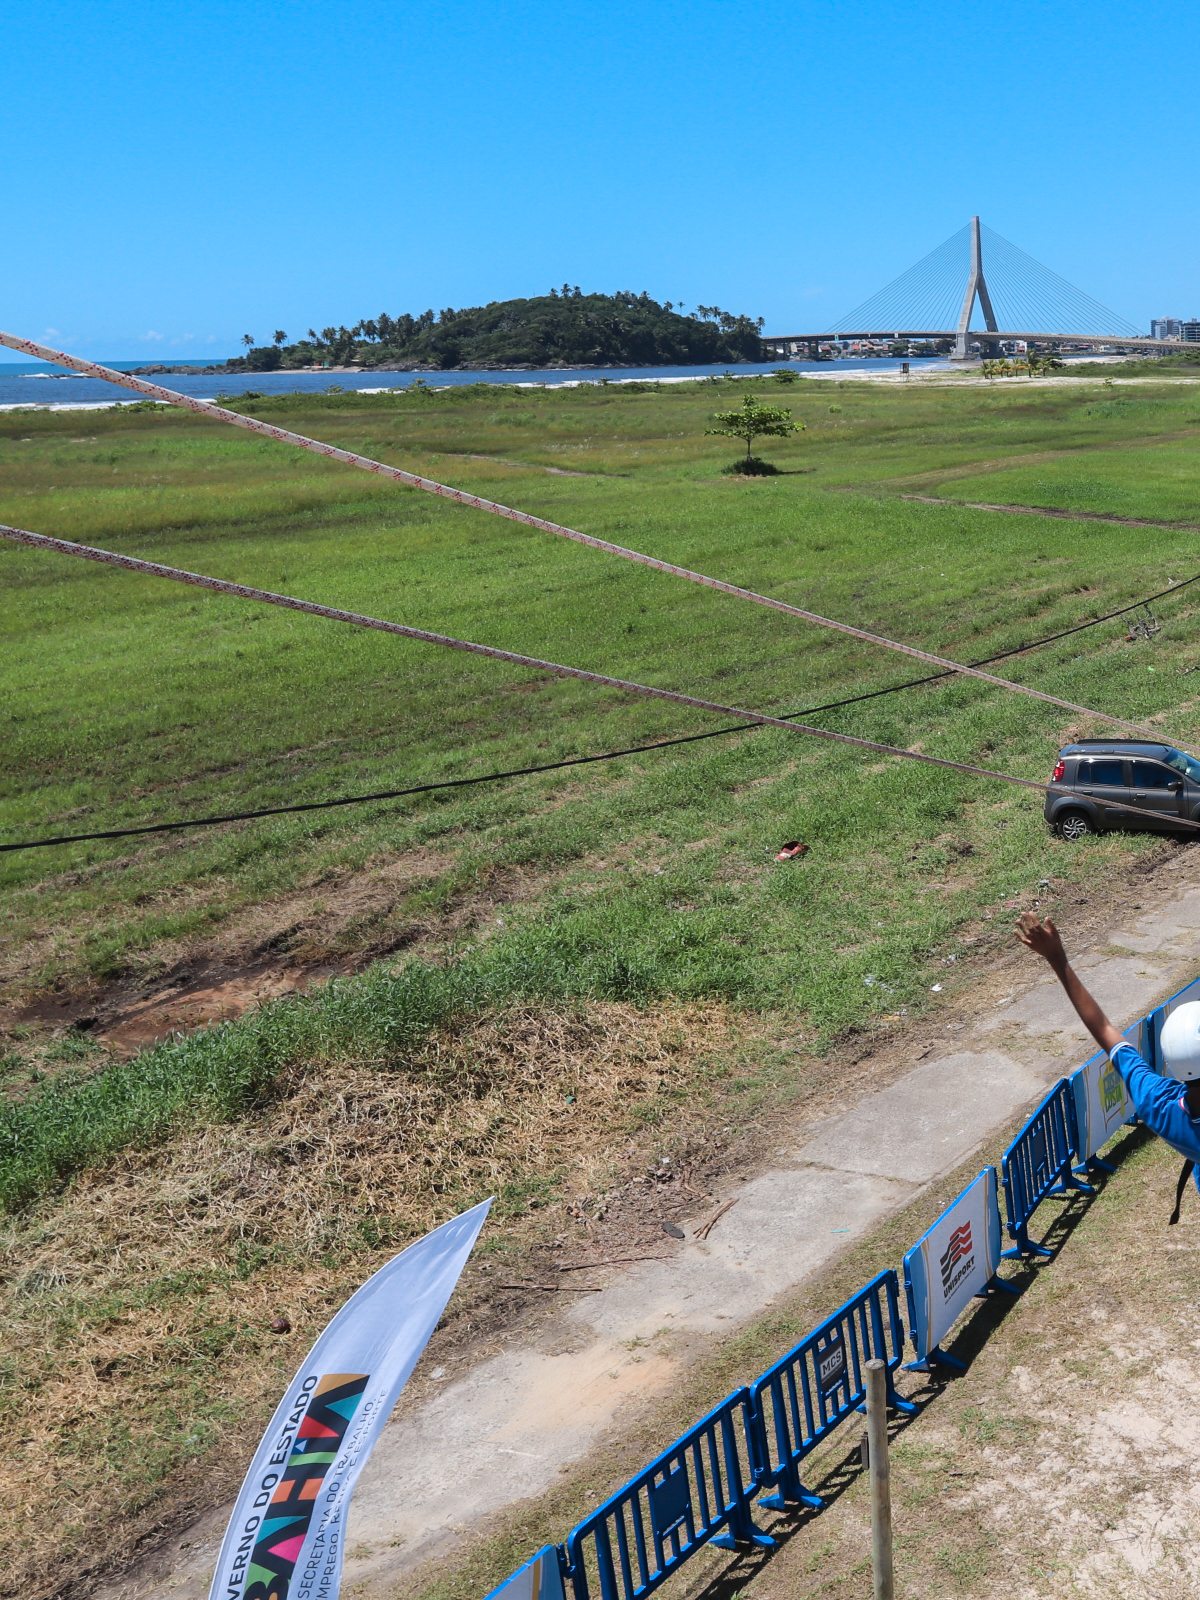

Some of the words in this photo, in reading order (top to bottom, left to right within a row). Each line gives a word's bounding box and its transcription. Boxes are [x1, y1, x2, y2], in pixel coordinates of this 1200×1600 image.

[943, 1255, 975, 1298] UNISPORT
[822, 1351, 842, 1376] MCS
[253, 1473, 279, 1509] DO
[269, 1375, 318, 1465] ESTADO
[353, 1388, 389, 1454] ESPORTE
[298, 1507, 332, 1599] SECRETARIA
[326, 1482, 341, 1503] DO
